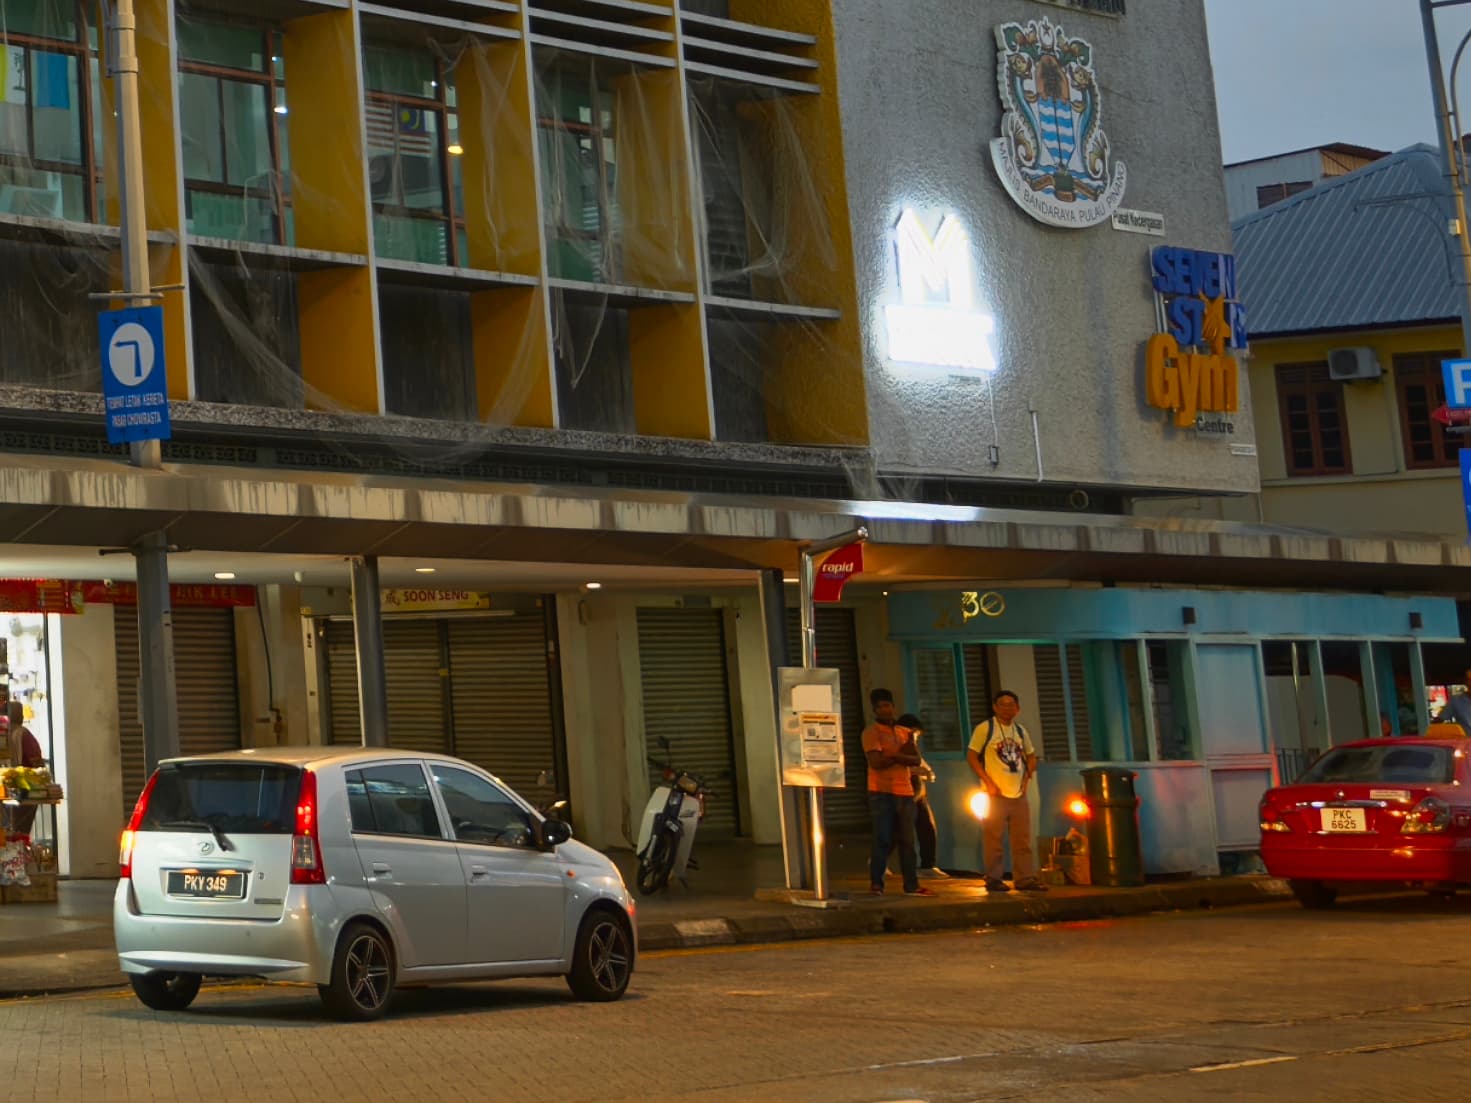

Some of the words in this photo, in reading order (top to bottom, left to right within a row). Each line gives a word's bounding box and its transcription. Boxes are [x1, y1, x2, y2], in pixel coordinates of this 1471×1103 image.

[1023, 190, 1075, 222] BANDARAYA
[1079, 202, 1106, 223] PULAU
[1106, 163, 1125, 208] PINANG
[1151, 246, 1237, 301] SEVEN
[1146, 332, 1239, 428] Gym
[143, 392, 164, 405] KERETA
[127, 412, 162, 426] CHOWRASTA
[1196, 416, 1234, 435] Centre
[822, 562, 854, 575] rapid
[404, 590, 435, 602] SOON
[439, 590, 469, 600] SENG
[1332, 809, 1352, 820] PKC
[1331, 820, 1357, 830] 6625
[184, 875, 205, 891] PKY
[206, 876, 227, 892] 349
